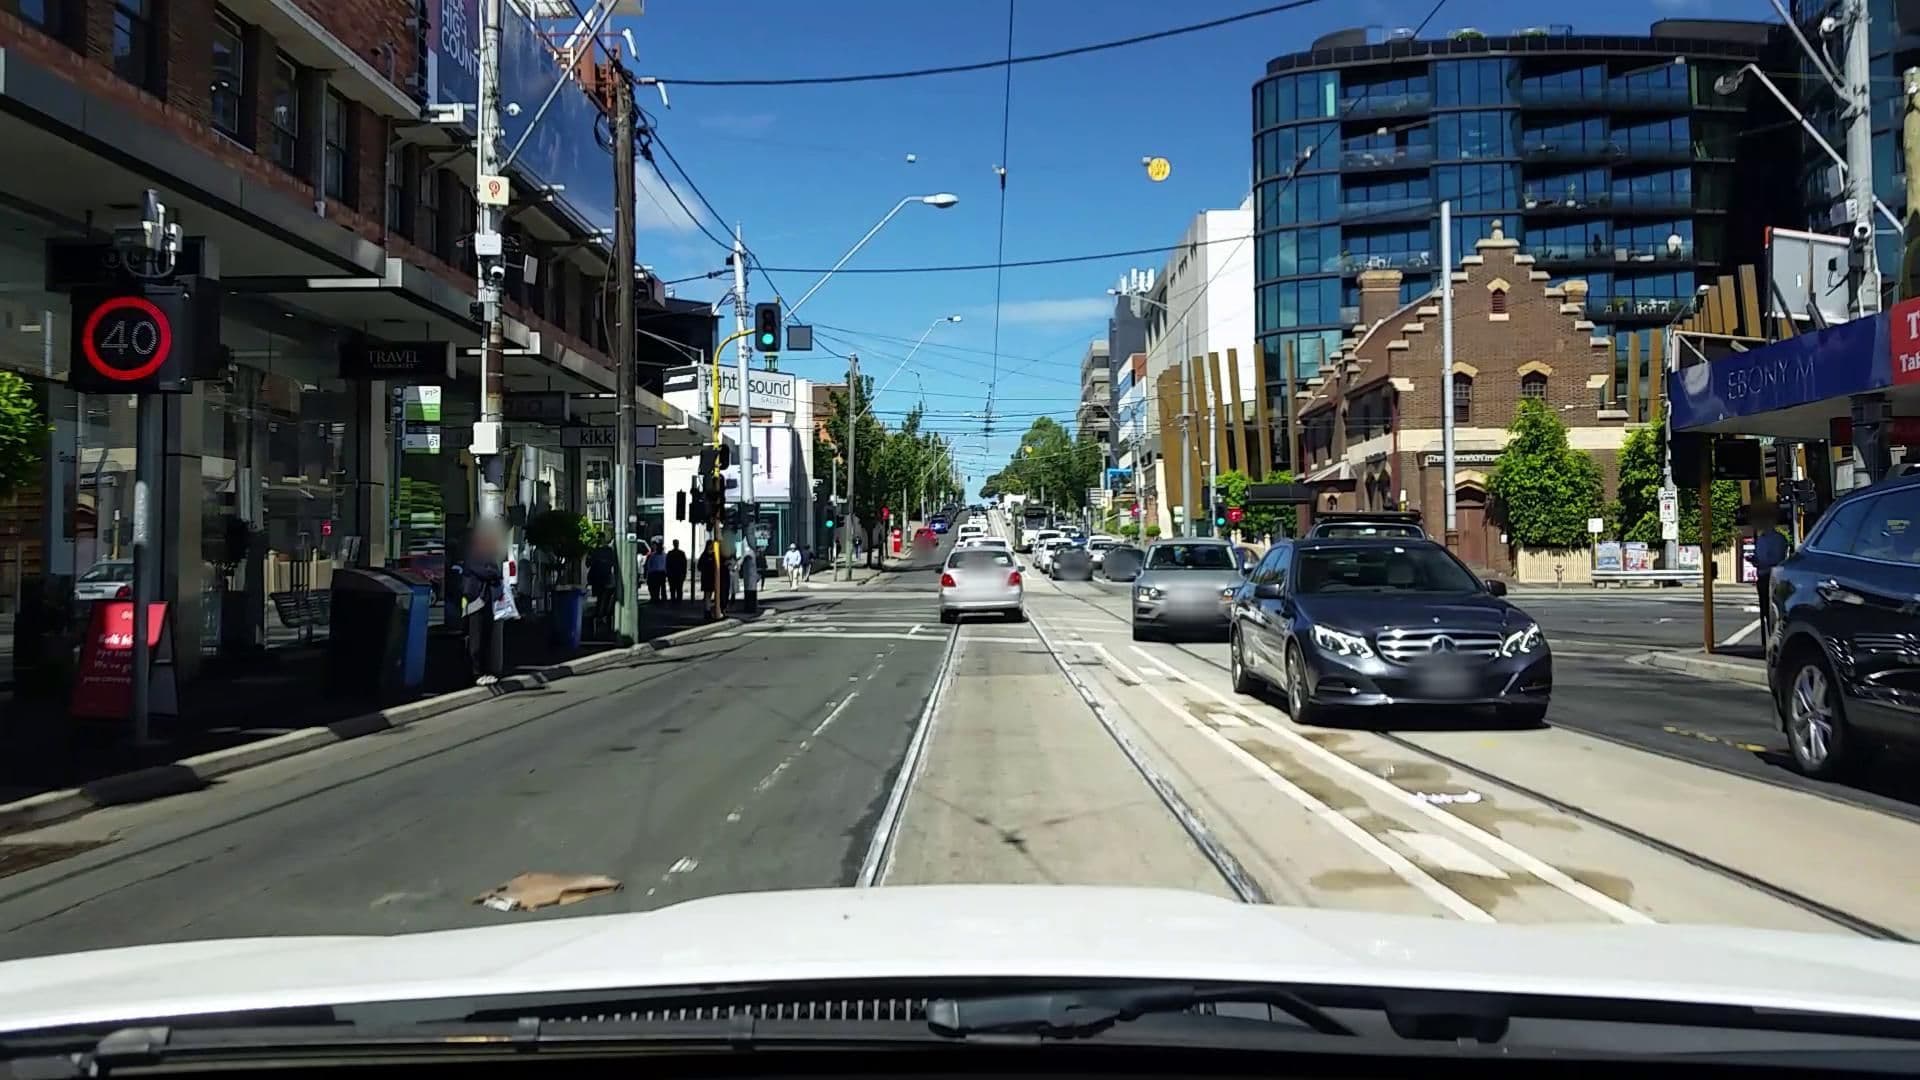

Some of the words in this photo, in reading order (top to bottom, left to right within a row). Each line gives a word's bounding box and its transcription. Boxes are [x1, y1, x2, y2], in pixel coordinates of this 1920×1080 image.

[442, 26, 480, 79] COUNT
[101, 320, 157, 354] 40
[749, 379, 790, 396] sound
